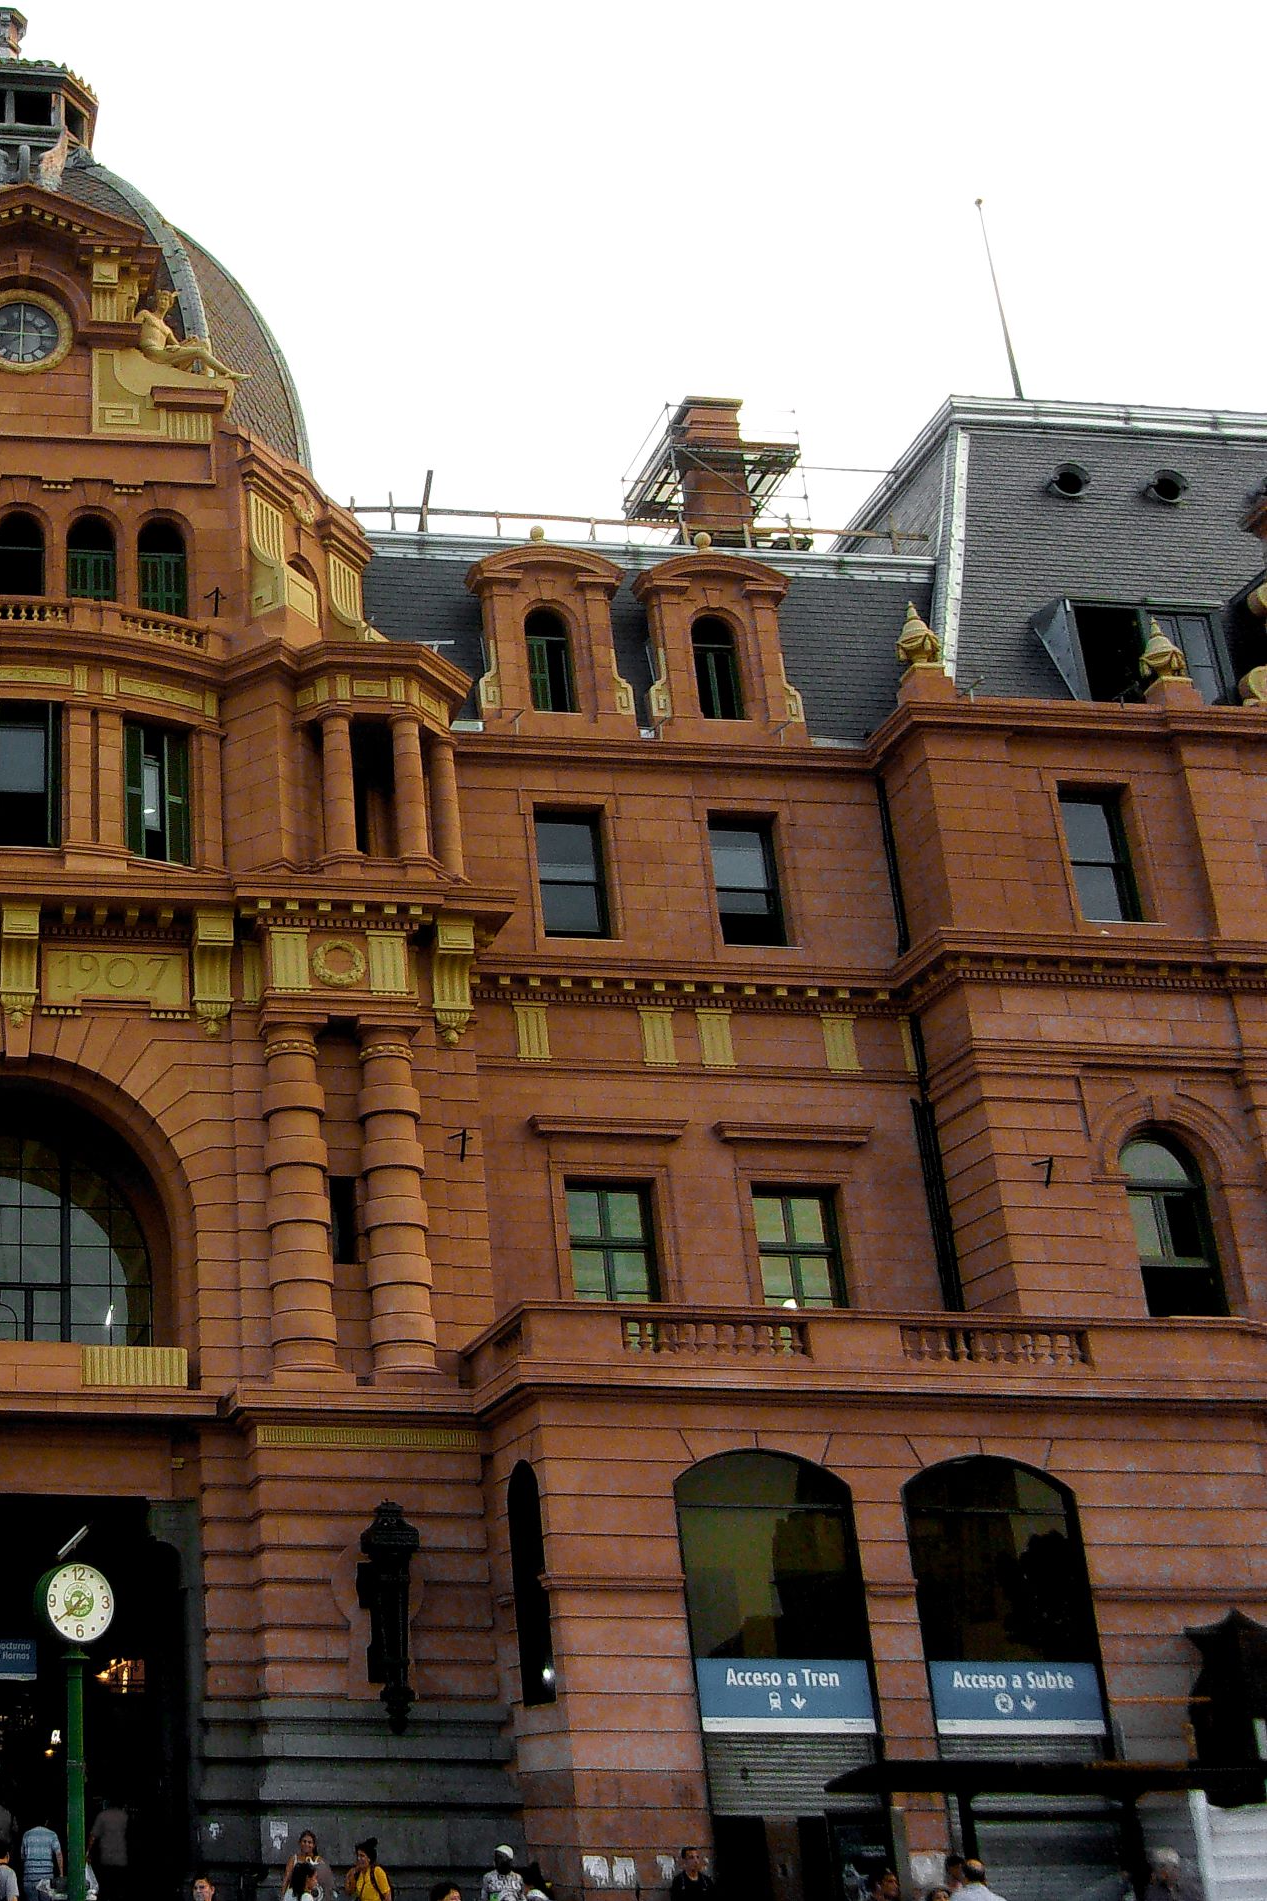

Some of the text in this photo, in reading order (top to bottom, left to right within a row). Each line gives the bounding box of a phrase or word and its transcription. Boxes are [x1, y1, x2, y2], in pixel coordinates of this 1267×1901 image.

[57, 953, 171, 992] 1907
[71, 1566, 86, 1581] 12
[48, 1593, 57, 1608] 9
[101, 1595, 110, 1610] 3
[75, 1623, 85, 1638] 6
[726, 1667, 840, 1688] Acceso a Tren
[953, 1670, 1075, 1690] Acceso a Subte
